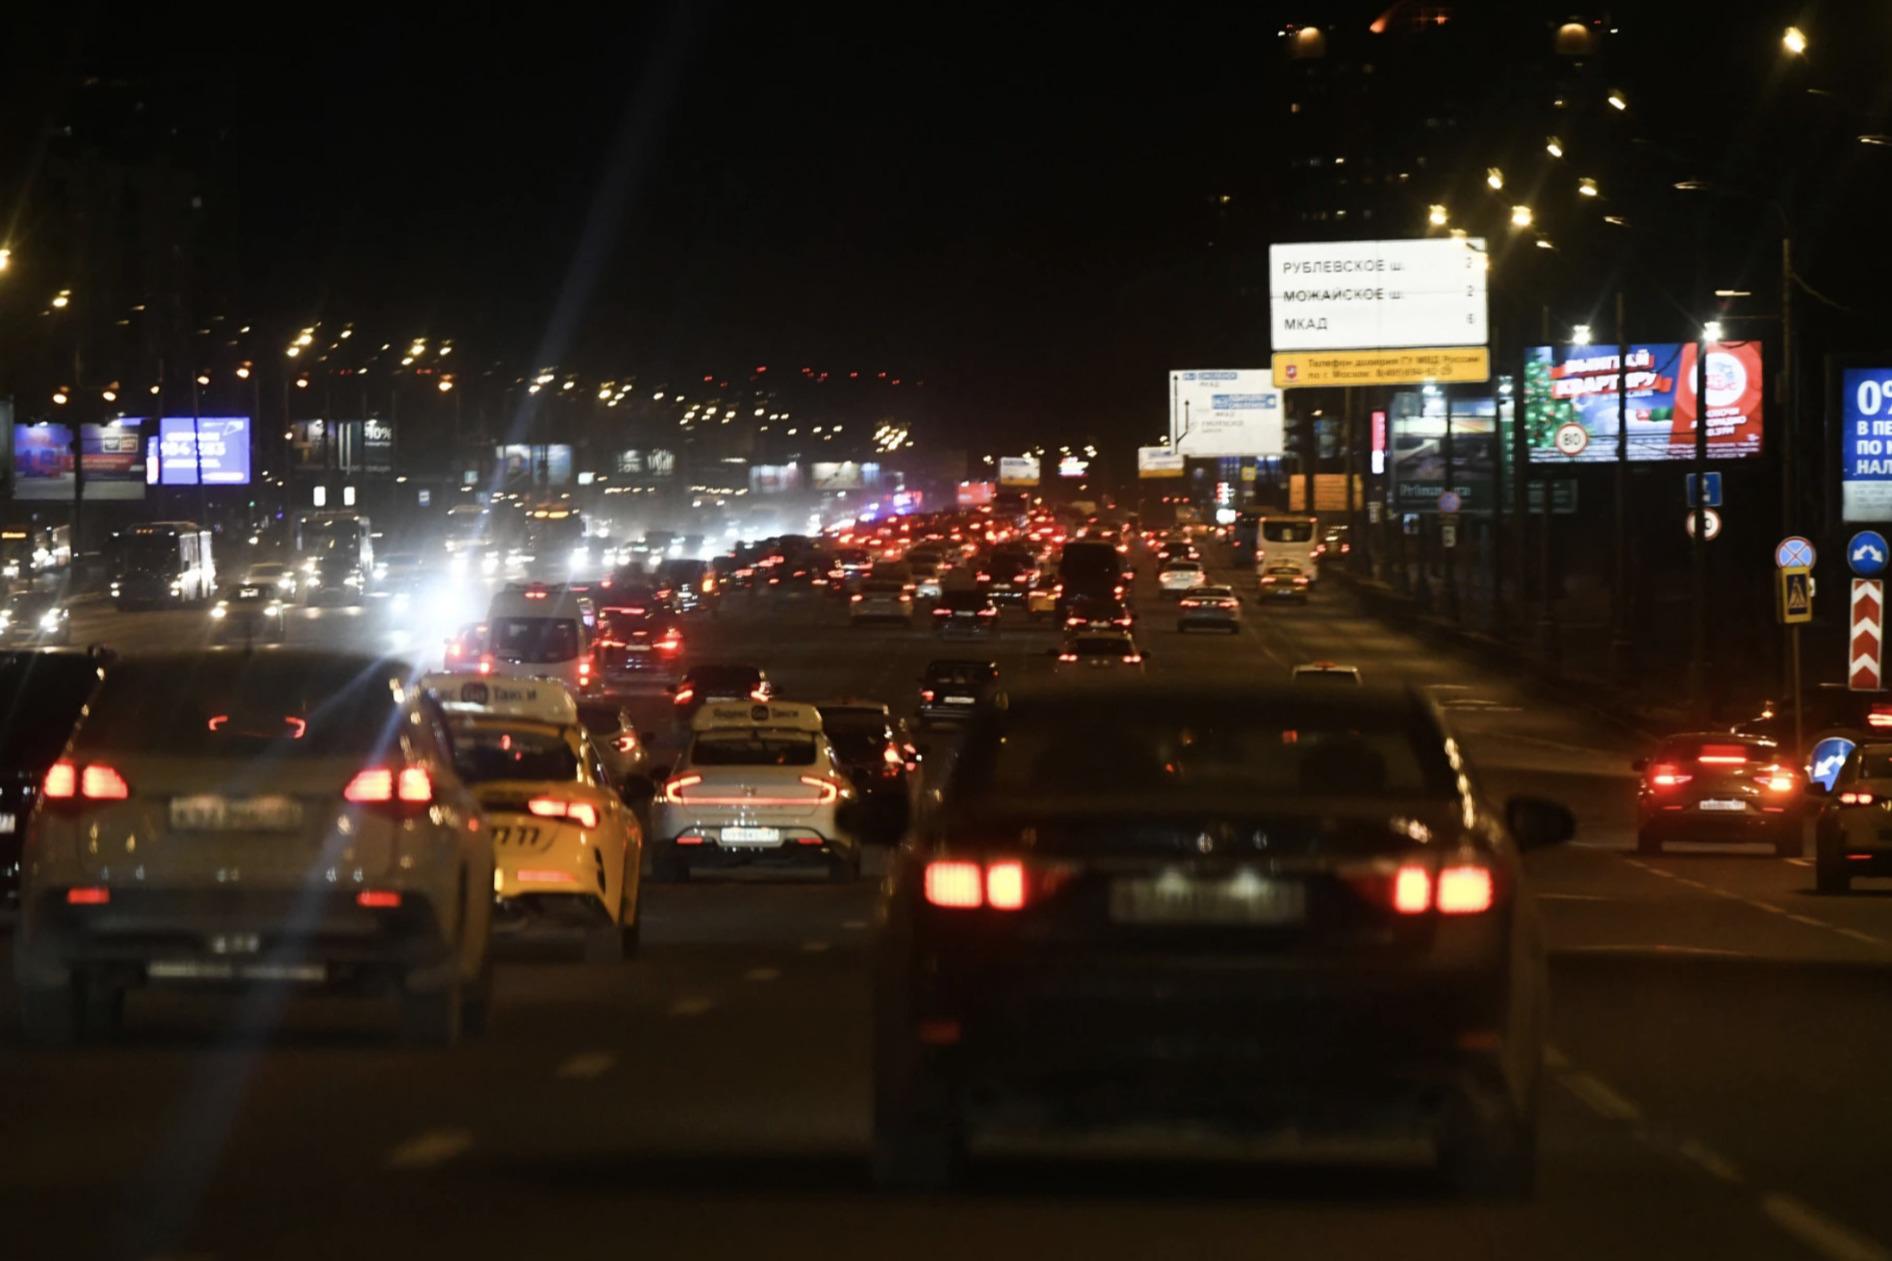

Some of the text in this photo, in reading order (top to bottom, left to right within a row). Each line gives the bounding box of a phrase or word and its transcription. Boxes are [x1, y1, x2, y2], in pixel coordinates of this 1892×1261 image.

[1282, 259, 1385, 274] РУБЛЕВСКОЕ
[1283, 287, 1384, 302] МОЖАЙСКОЕ
[1284, 317, 1328, 330] МКАД
[1857, 420, 1869, 436] В
[1856, 440, 1883, 456] ПО
